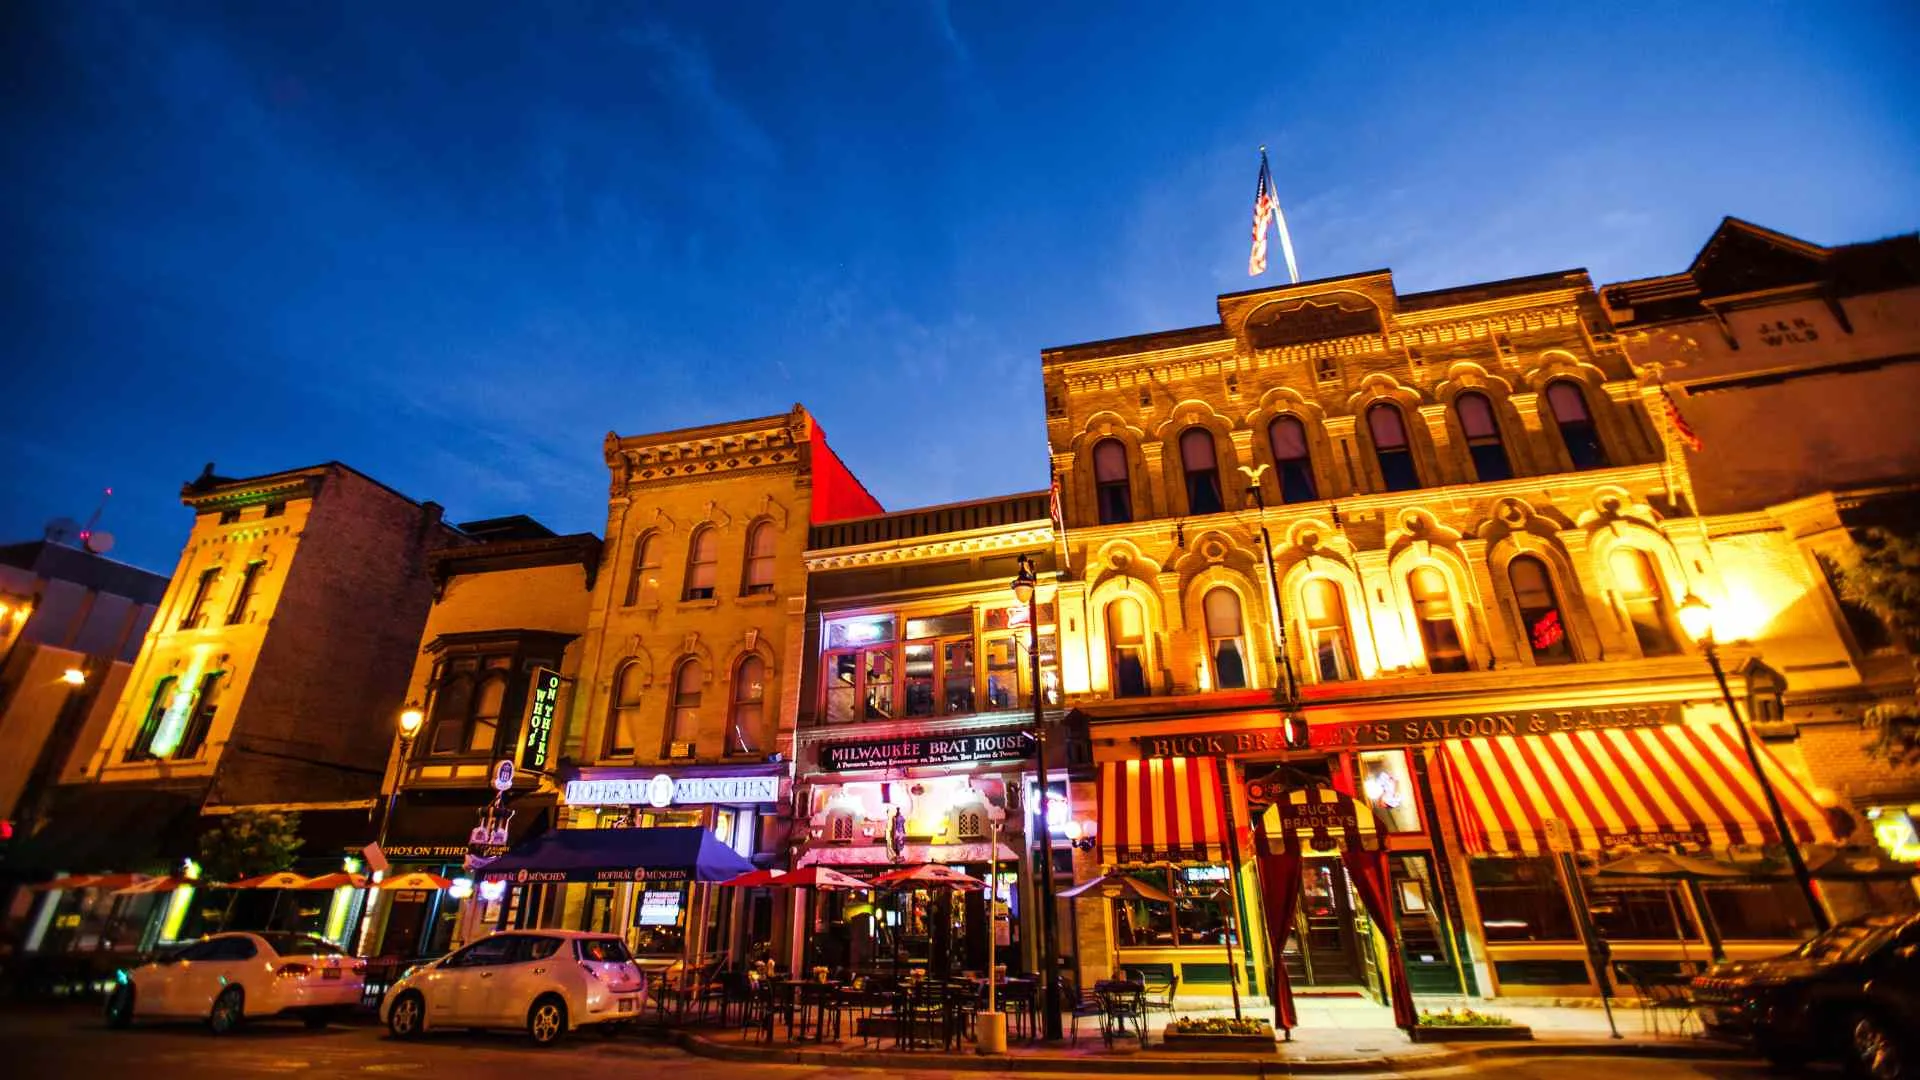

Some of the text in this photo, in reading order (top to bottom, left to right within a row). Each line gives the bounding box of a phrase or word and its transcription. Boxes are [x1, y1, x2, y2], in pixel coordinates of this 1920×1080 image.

[528, 688, 546, 747] WHO'S
[534, 677, 559, 766] ON THIRD
[1152, 735, 1225, 757] BUCK
[1405, 714, 1517, 740] SALOON
[1528, 713, 1547, 732] &
[1554, 705, 1671, 730] EATERY
[831, 742, 920, 761] MILWAUKEE
[929, 739, 969, 755] BRAT
[975, 735, 1026, 752] HOUSE
[1296, 804, 1337, 815] BUCK
[414, 847, 430, 855] ON
[433, 847, 469, 855] THIRD
